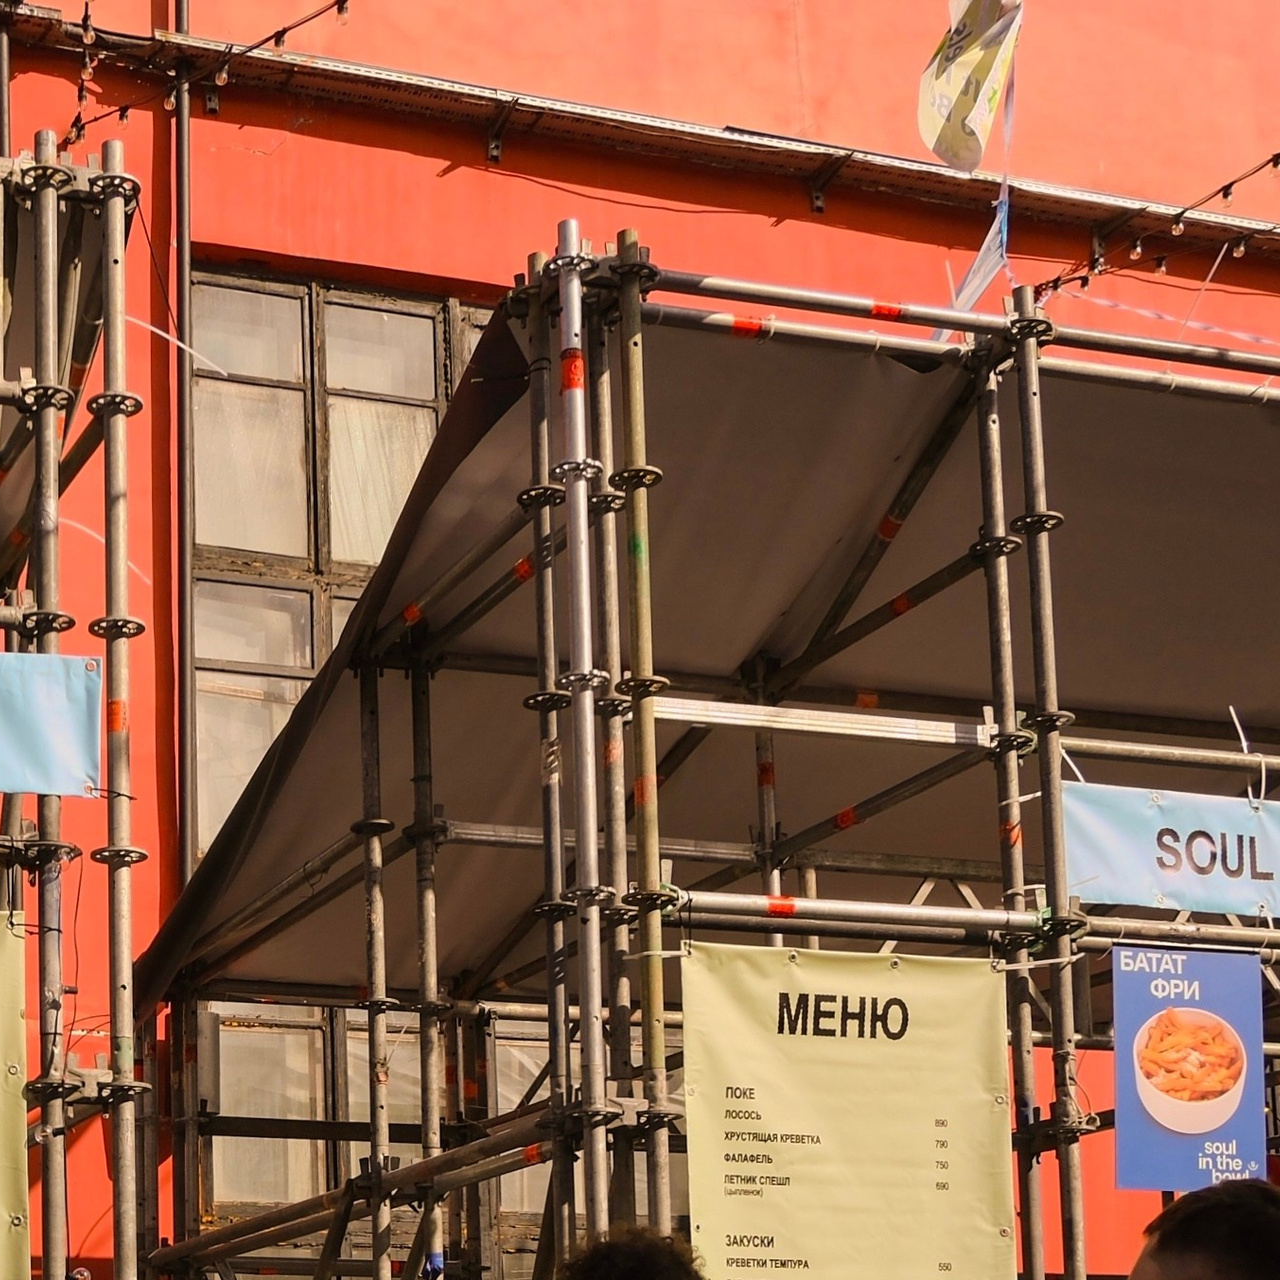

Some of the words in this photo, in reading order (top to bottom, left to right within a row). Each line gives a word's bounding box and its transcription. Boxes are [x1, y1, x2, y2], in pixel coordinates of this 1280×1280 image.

[1154, 827, 1275, 881] SOUL
[1120, 950, 1187, 975] БАТАТ
[1149, 977, 1201, 1001] ФРИ
[776, 991, 910, 1041] МЕНЮ
[725, 1086, 756, 1100] ПОКЕ
[723, 1109, 762, 1121] ЛОСОСЬ
[723, 1131, 778, 1144] ХРУСТЯЩАЯ
[779, 1133, 822, 1146] КРЕВЕТКА
[1204, 1139, 1237, 1155] soul
[723, 1152, 774, 1165] ФАЛАФЕЛЬ
[1198, 1152, 1213, 1170] in
[1216, 1154, 1243, 1171] the
[723, 1173, 758, 1186] ЛЕТНИК
[758, 1175, 791, 1187] СПЕШЛ
[725, 1234, 775, 1249] ЗАКУСКИ
[725, 1257, 768, 1269] КРЕВЕТКИ
[769, 1258, 810, 1270] ТЕМПУРА
[938, 1262, 953, 1273] 550
